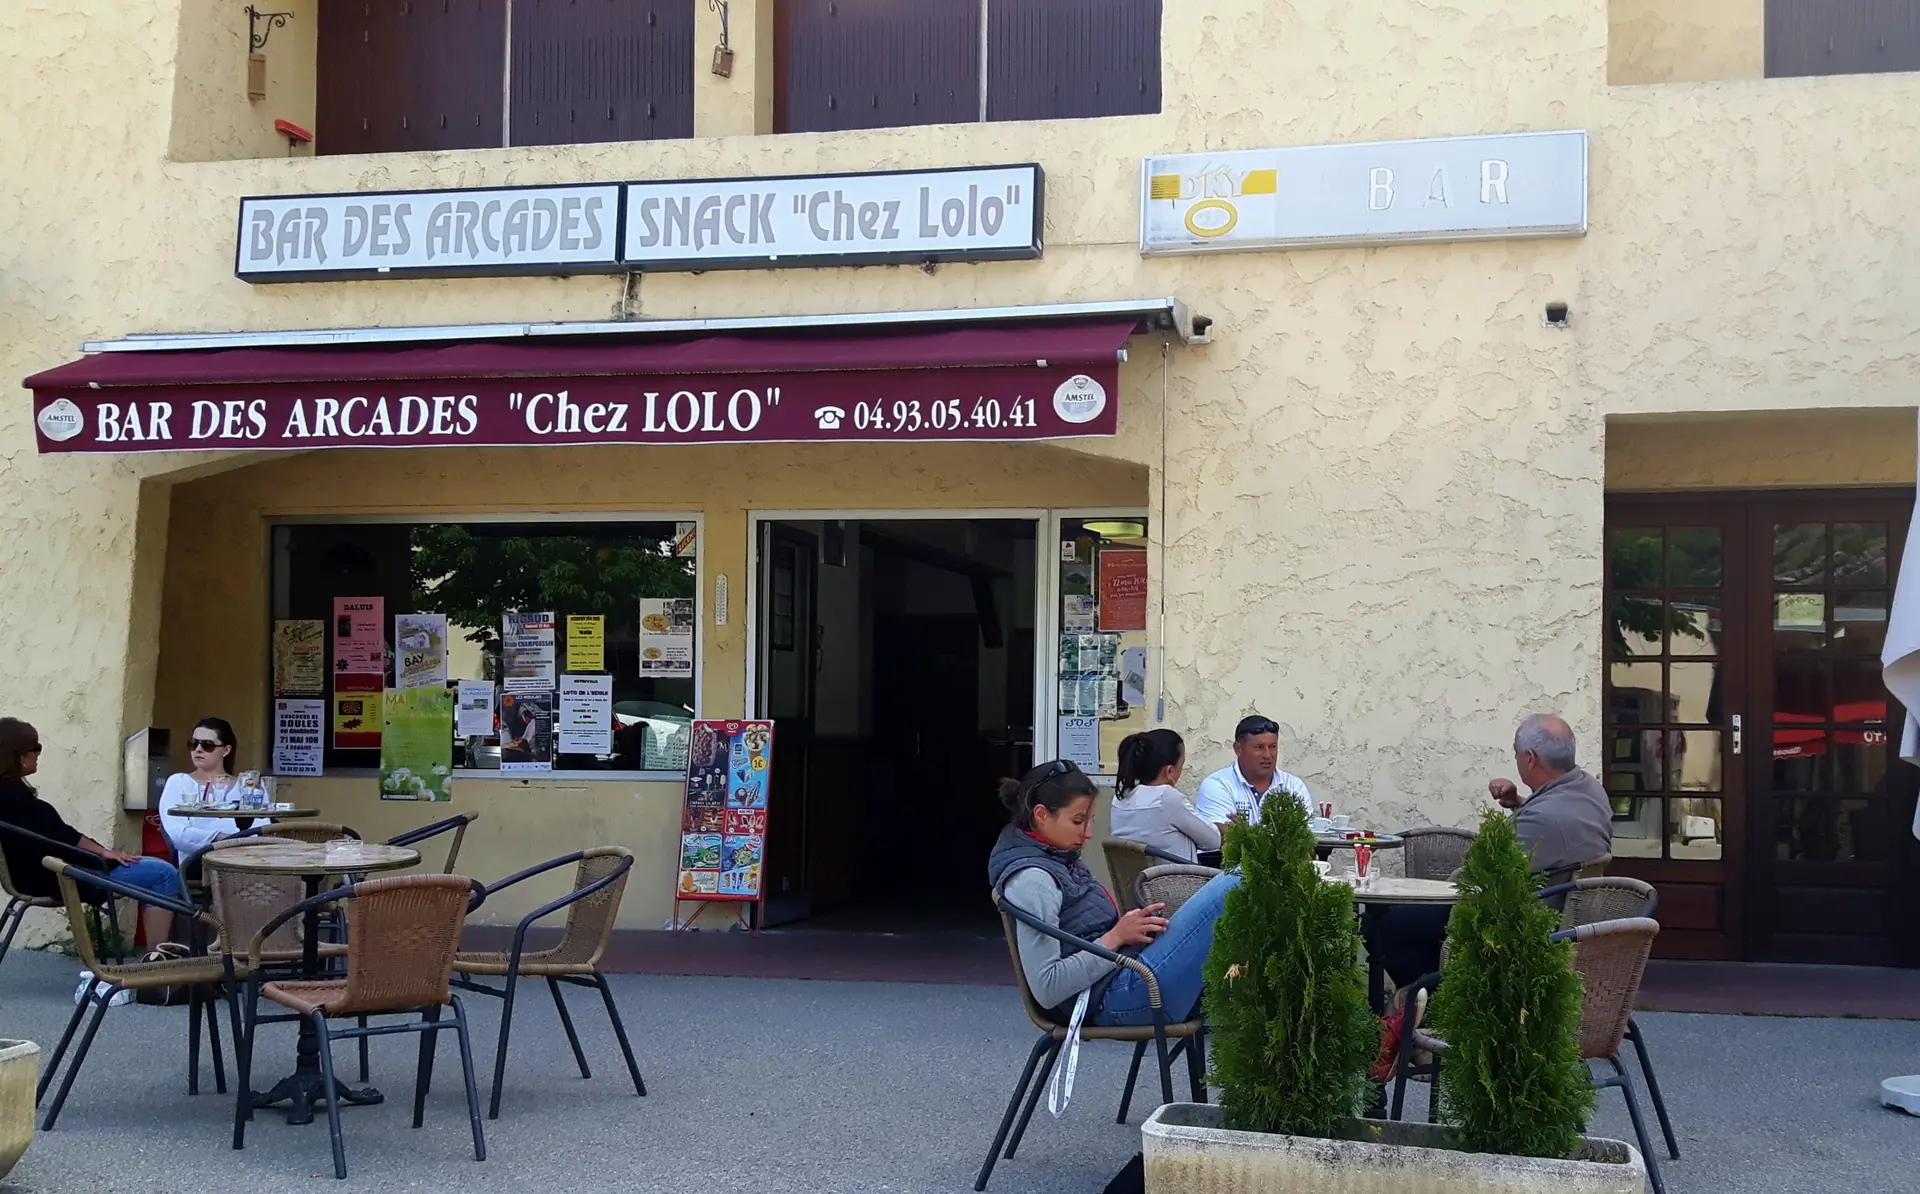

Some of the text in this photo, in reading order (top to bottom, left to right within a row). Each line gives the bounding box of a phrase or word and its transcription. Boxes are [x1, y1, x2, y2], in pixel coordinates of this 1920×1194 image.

[639, 184, 1021, 252] SNACK "Chez Lolo"
[250, 196, 603, 266] BAR DES ARCADES
[1065, 394, 1095, 402] AMSTEL
[47, 414, 75, 422] AMSTEL
[95, 387, 781, 442] BAR DES ARCADES "Chez LOLO"
[854, 396, 1038, 432] 04.93.05.40.41
[280, 720, 320, 728] BOULES
[280, 736, 288, 744] 21
[290, 736, 304, 744] MAI
